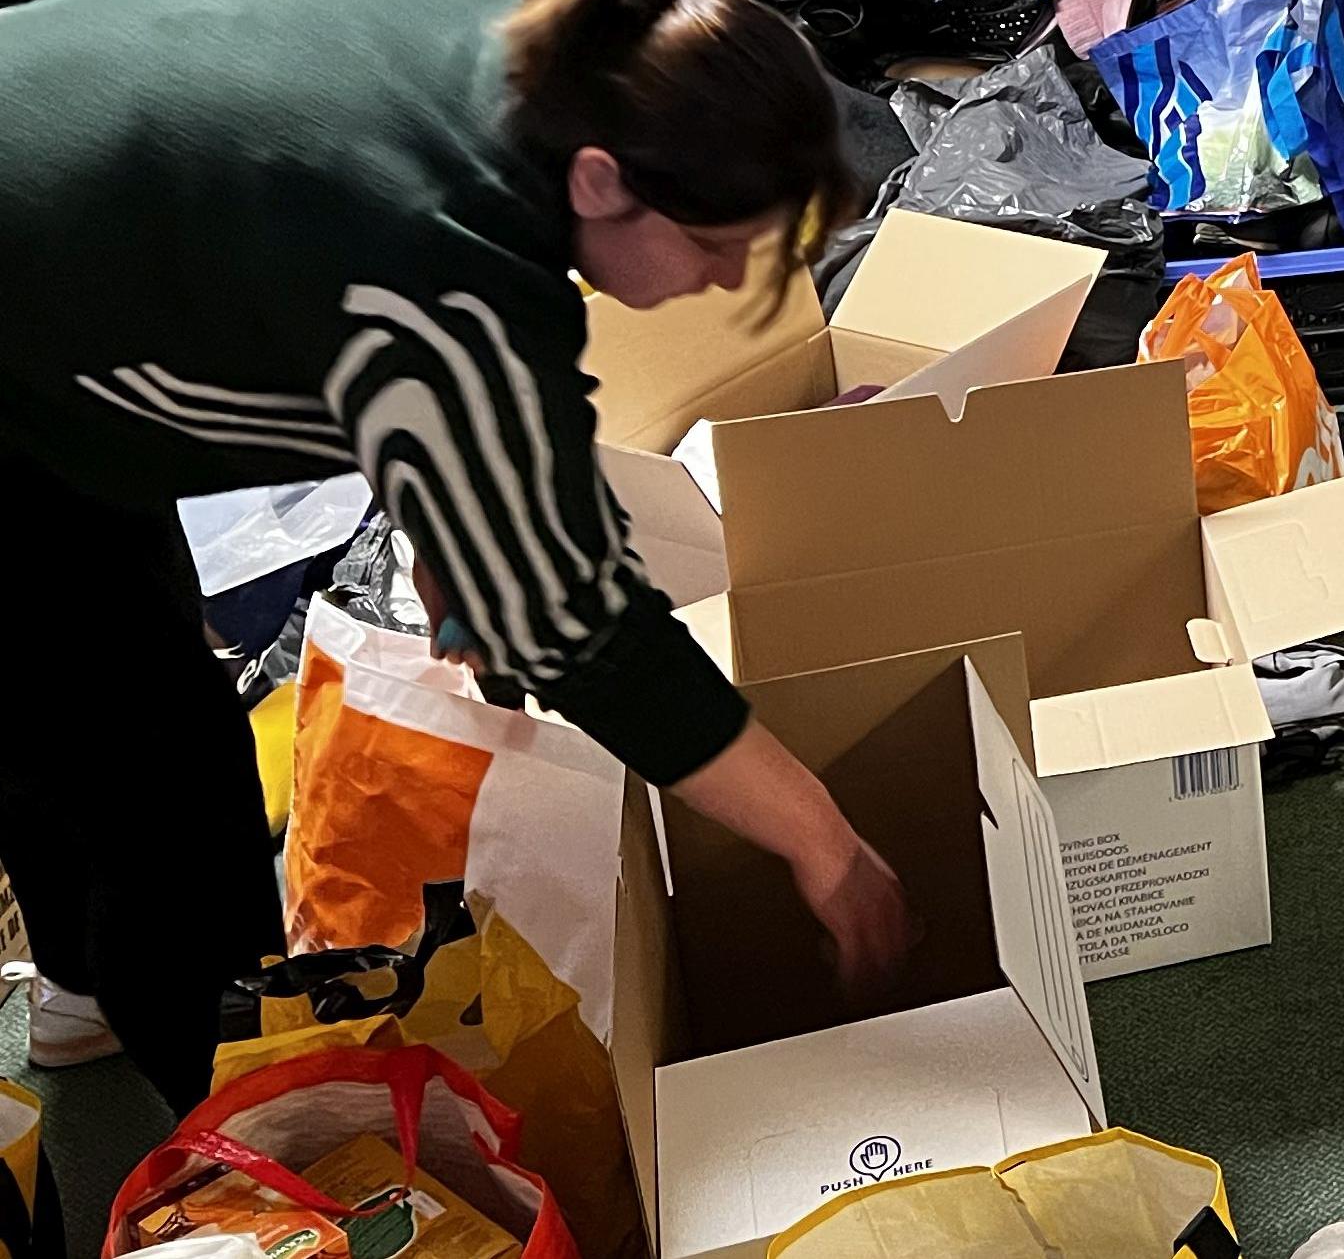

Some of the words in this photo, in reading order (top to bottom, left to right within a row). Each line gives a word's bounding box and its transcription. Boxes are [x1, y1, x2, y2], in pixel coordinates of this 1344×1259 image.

[1059, 838, 1094, 853] OVING
[1097, 833, 1121, 844] BOX
[1062, 845, 1129, 864] RHUISDOOS
[1065, 864, 1097, 878] RTON
[1100, 860, 1114, 870] DE
[1066, 867, 1147, 891] ZUGSKARTON
[1094, 888, 1112, 899] DO
[1072, 899, 1116, 916] HOVACÍ
[1105, 912, 1121, 922] NA
[1087, 929, 1101, 939] DE
[1104, 916, 1164, 935] MUDANZA
[1079, 939, 1108, 952] TOLA
[1111, 936, 1128, 946] DA
[1130, 923, 1189, 942] TRASLOCO
[1078, 947, 1130, 965] TTEKASSE
[820, 1177, 863, 1195] PUSH
[893, 1158, 934, 1176] HERE
